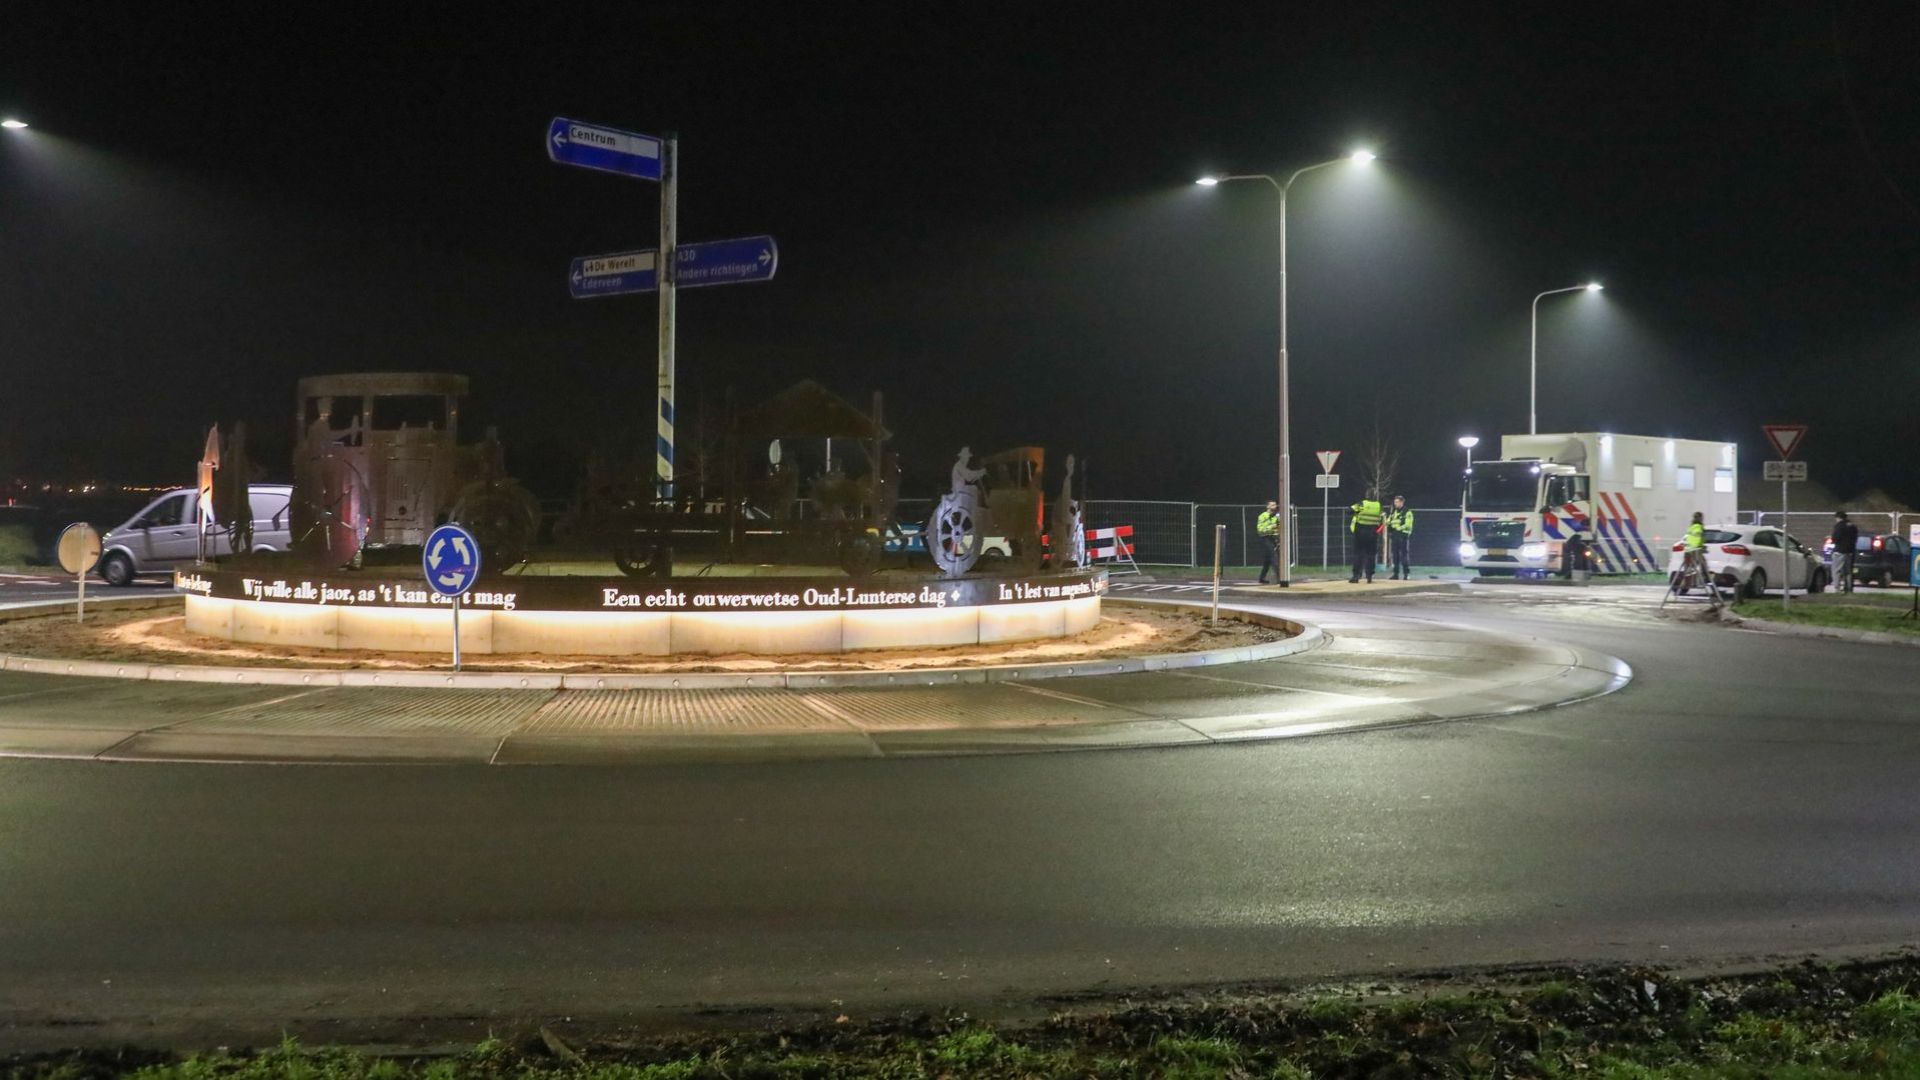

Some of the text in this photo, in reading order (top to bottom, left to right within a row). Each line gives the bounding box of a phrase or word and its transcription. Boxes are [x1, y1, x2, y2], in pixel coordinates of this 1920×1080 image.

[571, 127, 616, 146] Centrum
[677, 249, 696, 262] A30
[594, 261, 605, 272] De
[677, 263, 758, 281] Andere richtingen
[582, 277, 622, 289] Ederveen
[242, 578, 263, 601] Wij
[263, 580, 292, 599] wille
[293, 582, 318, 600] alle
[319, 583, 355, 604] jaor,
[358, 588, 376, 602] as
[395, 585, 427, 603] kan
[474, 592, 516, 611] mag
[602, 586, 946, 608] Een echt ouwerwetse Oud-Lunterse dag
[999, 583, 1013, 600] In
[1024, 582, 1041, 599] lest
